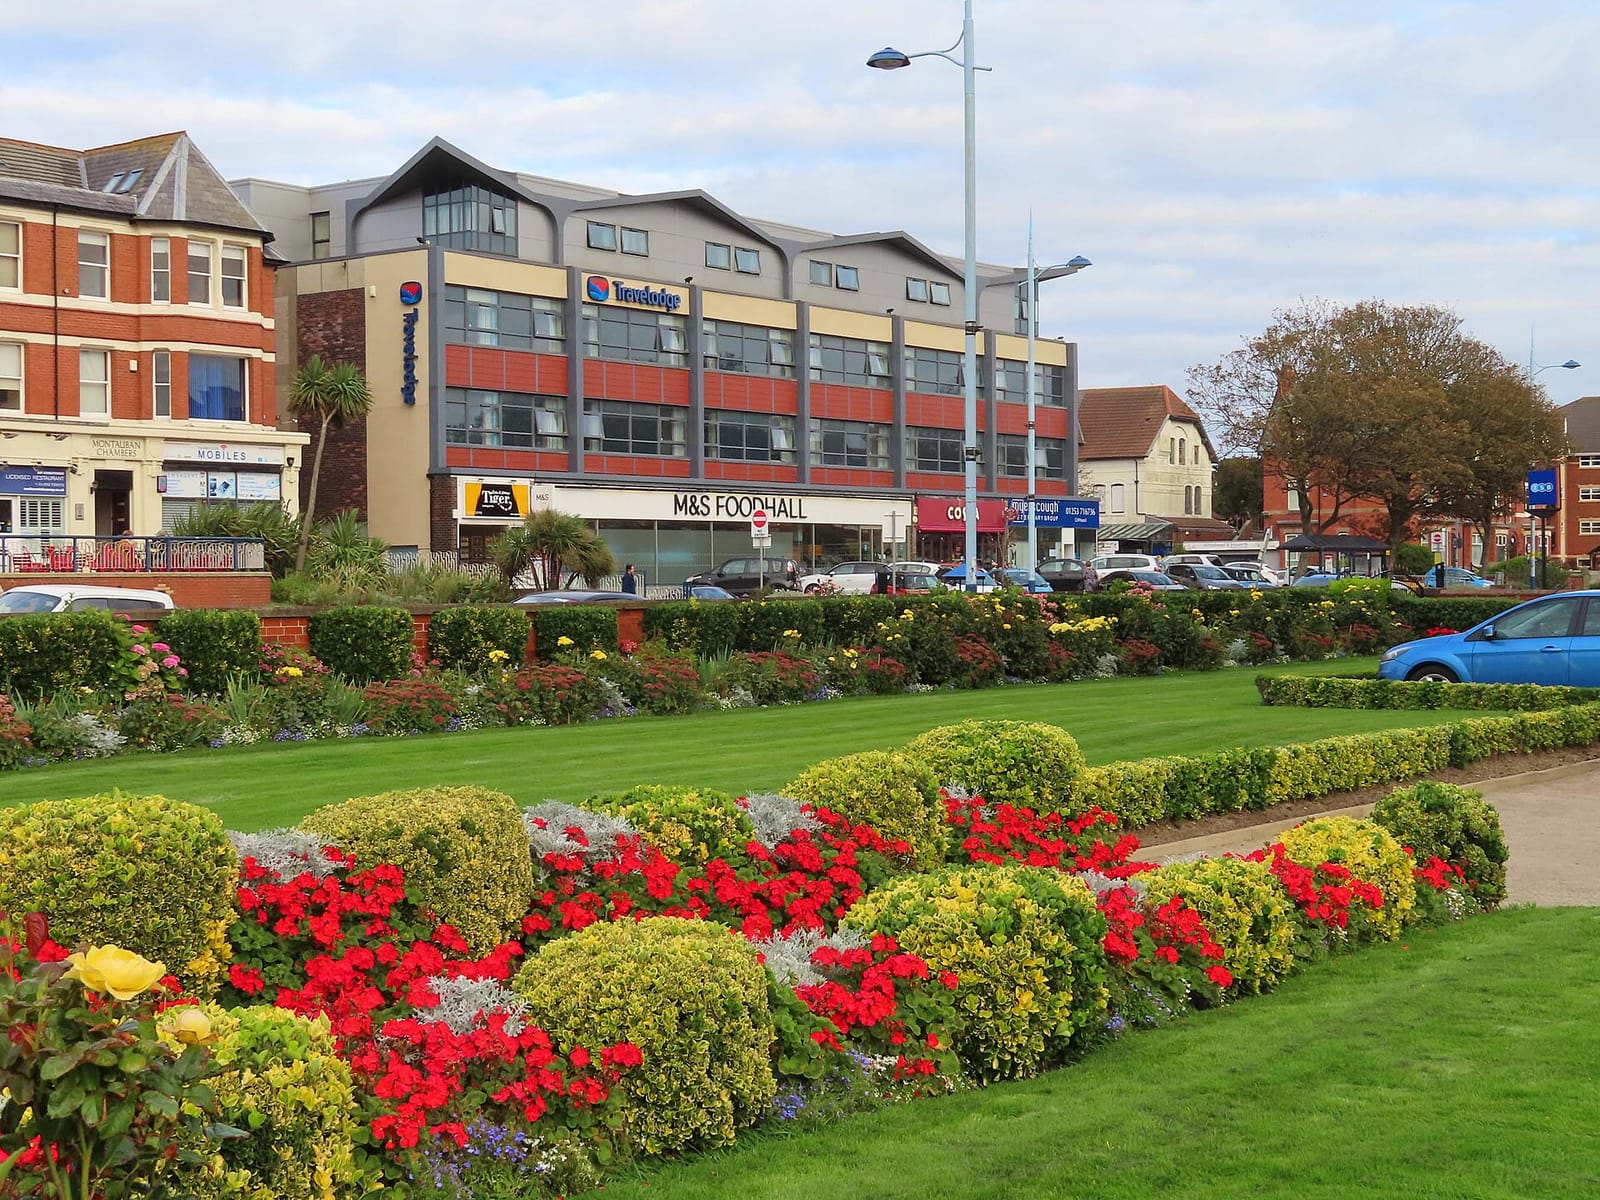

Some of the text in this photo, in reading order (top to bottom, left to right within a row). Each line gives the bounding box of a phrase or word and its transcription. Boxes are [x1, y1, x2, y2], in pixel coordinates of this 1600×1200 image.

[612, 280, 682, 312] Travelodge
[400, 307, 419, 406] Travelodge
[91, 439, 141, 449] MONTAUBAN
[96, 448, 137, 457] CHAMBERS
[198, 450, 247, 461] MOBILES
[1531, 482, 1553, 493] TSB
[482, 490, 511, 505] Tiger
[536, 493, 550, 501] M&S
[673, 493, 808, 519] M&S FOODHALL
[1012, 501, 1059, 514] myecough
